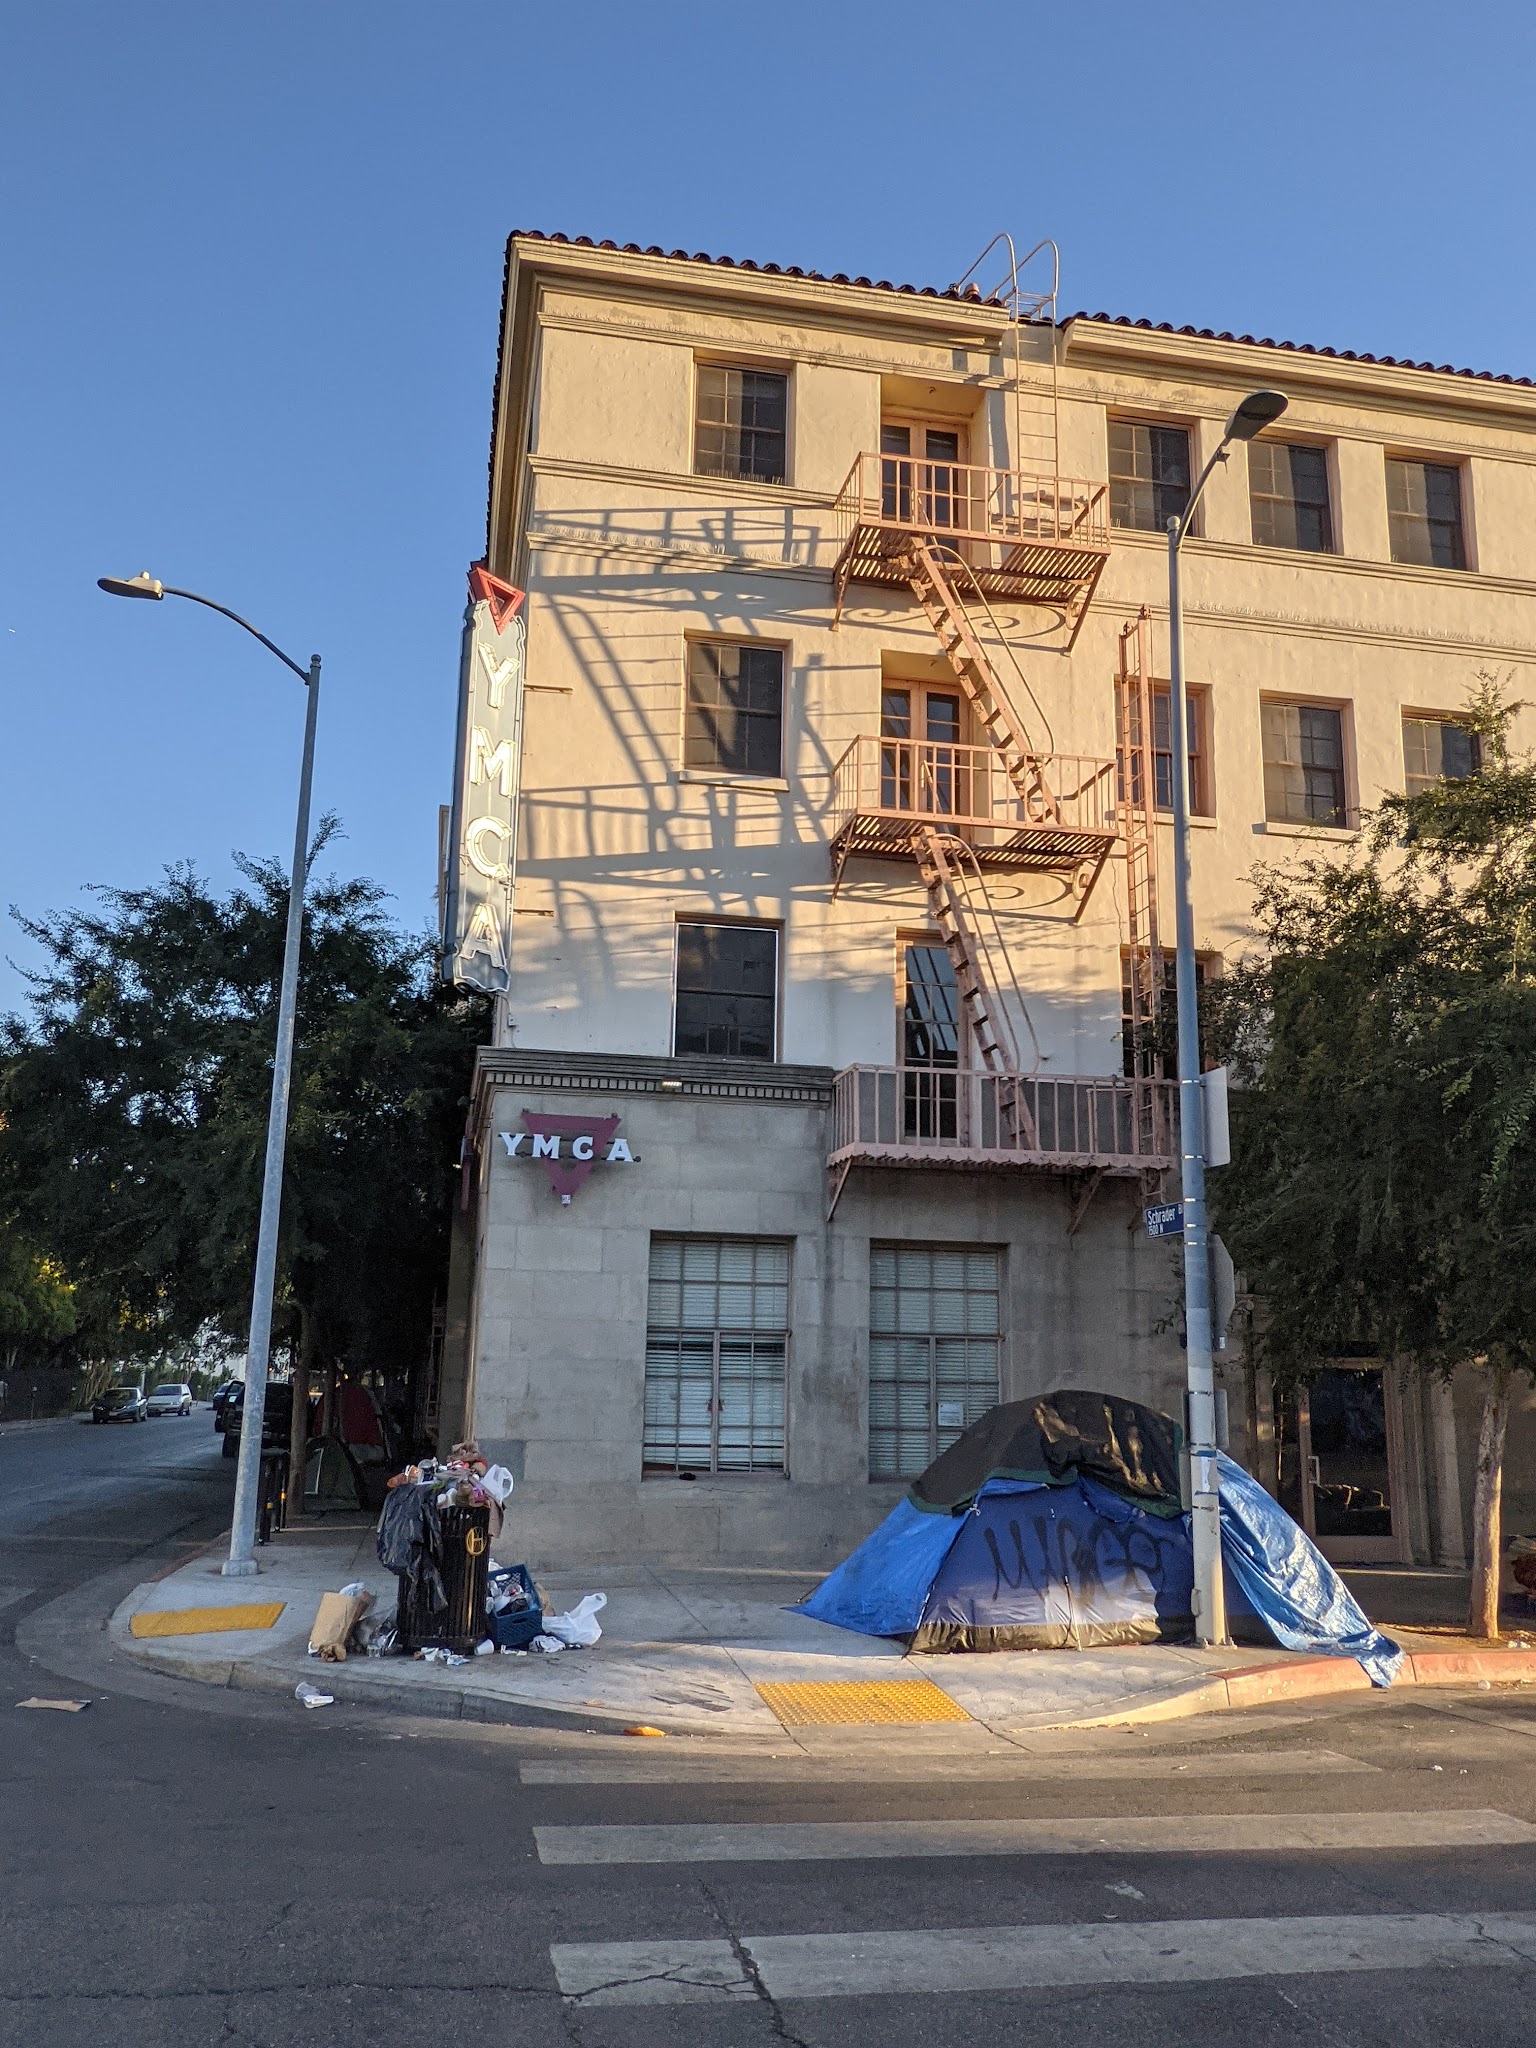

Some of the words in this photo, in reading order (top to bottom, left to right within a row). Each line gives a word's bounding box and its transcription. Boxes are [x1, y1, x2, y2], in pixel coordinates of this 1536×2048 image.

[462, 641, 520, 969] YMCA
[500, 1132, 633, 1162] YMCA
[1147, 1208, 1175, 1225] Schrader
